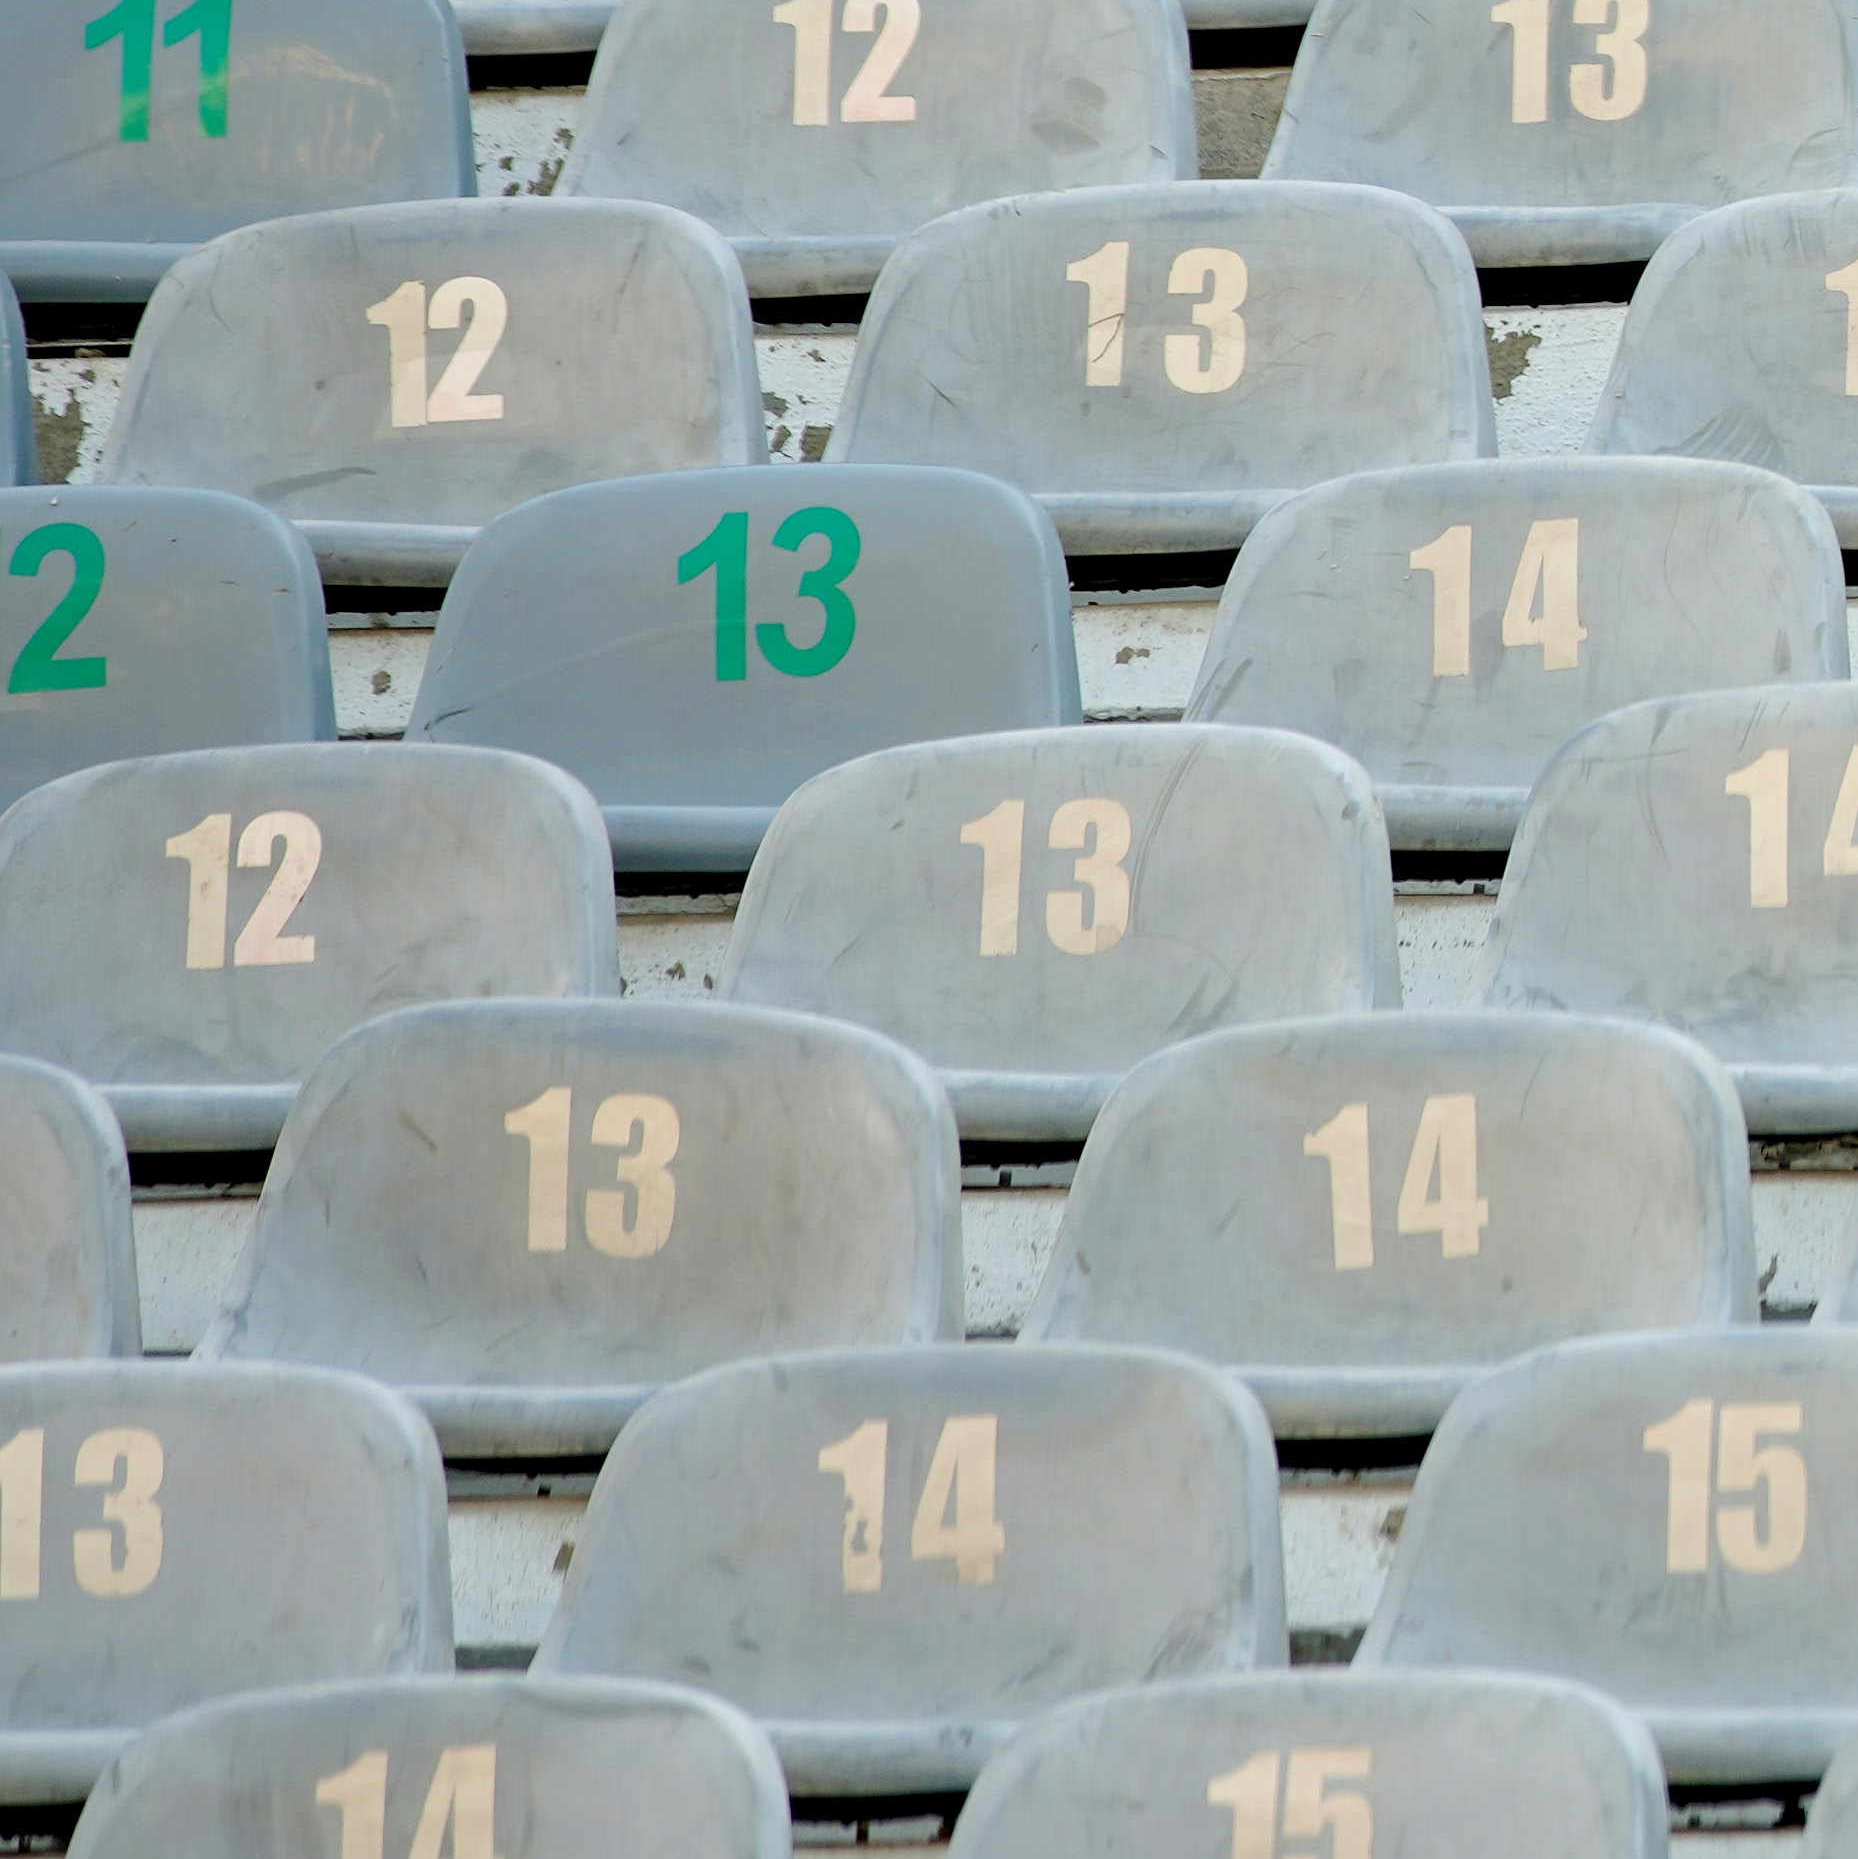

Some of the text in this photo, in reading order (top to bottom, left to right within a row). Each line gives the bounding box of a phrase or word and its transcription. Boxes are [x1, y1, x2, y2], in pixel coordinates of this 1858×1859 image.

[364, 277, 507, 428] 12
[1066, 242, 1251, 395] 13
[9, 523, 107, 693] 2
[678, 507, 861, 681] 13
[1410, 517, 1588, 676] 14
[164, 811, 322, 969] 12
[960, 798, 1131, 956] 13
[503, 1087, 680, 1257] 13
[1303, 1094, 1488, 1268] 14
[0, 1428, 164, 1599] 13
[818, 1415, 1005, 1591] 14
[1643, 1400, 1808, 1574] 15
[1208, 1746, 1373, 1859] 15
